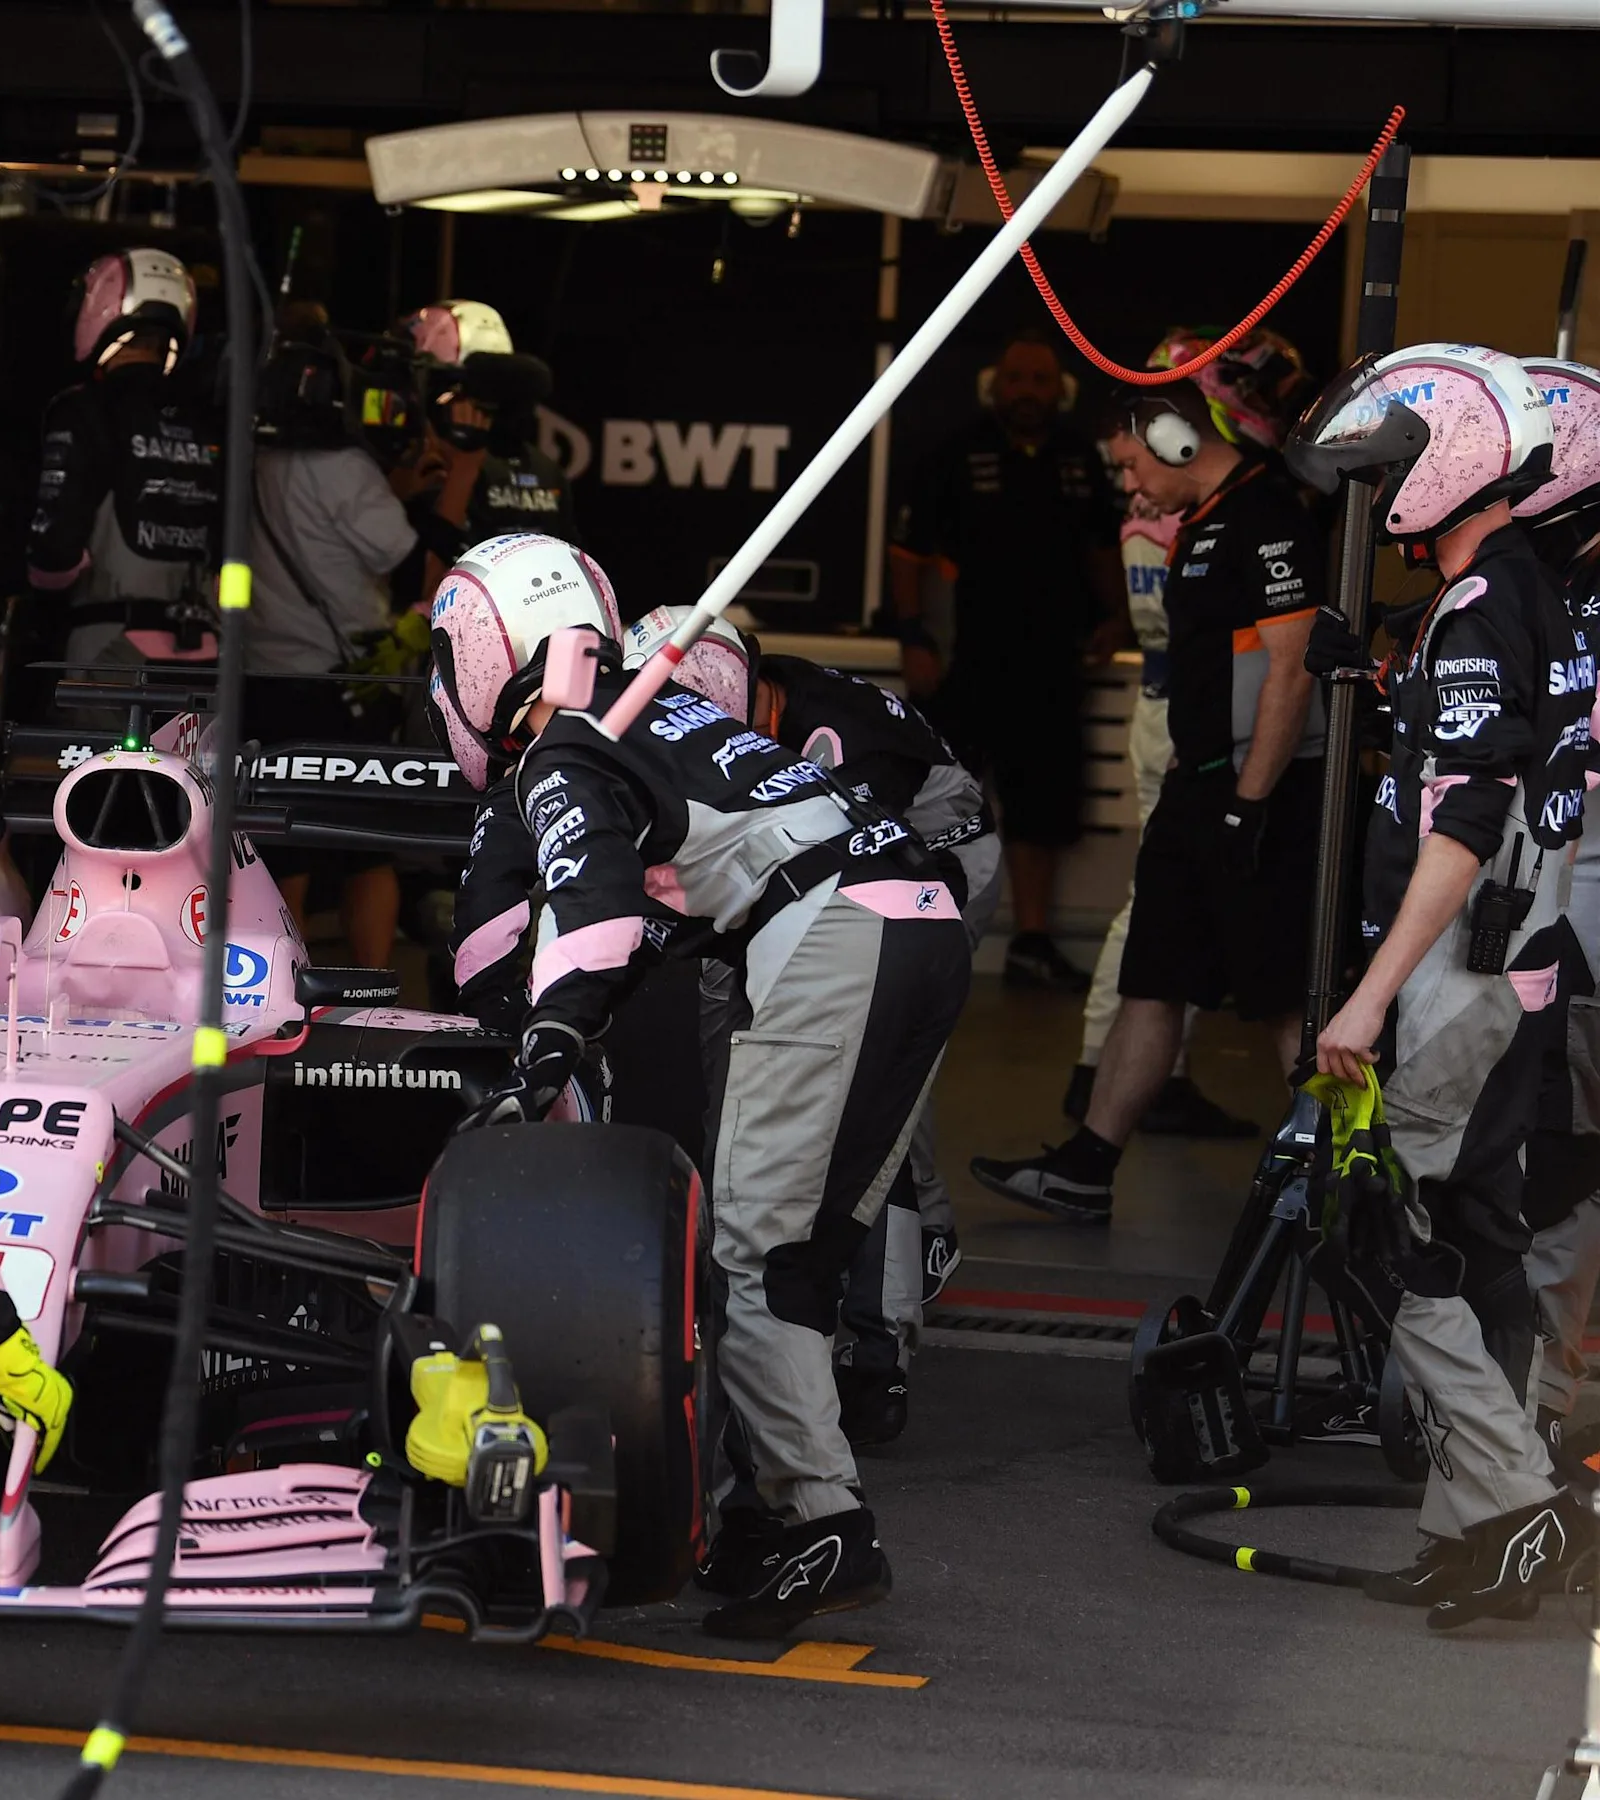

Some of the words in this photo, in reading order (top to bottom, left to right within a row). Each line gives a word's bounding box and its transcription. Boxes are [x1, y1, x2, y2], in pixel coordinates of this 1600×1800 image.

[602, 419, 790, 491] BWT
[523, 580, 580, 606] SCHUBERTH
[1434, 658, 1500, 681] KINGFISHER
[225, 993, 266, 1007] WT
[294, 1061, 462, 1090] infinitum
